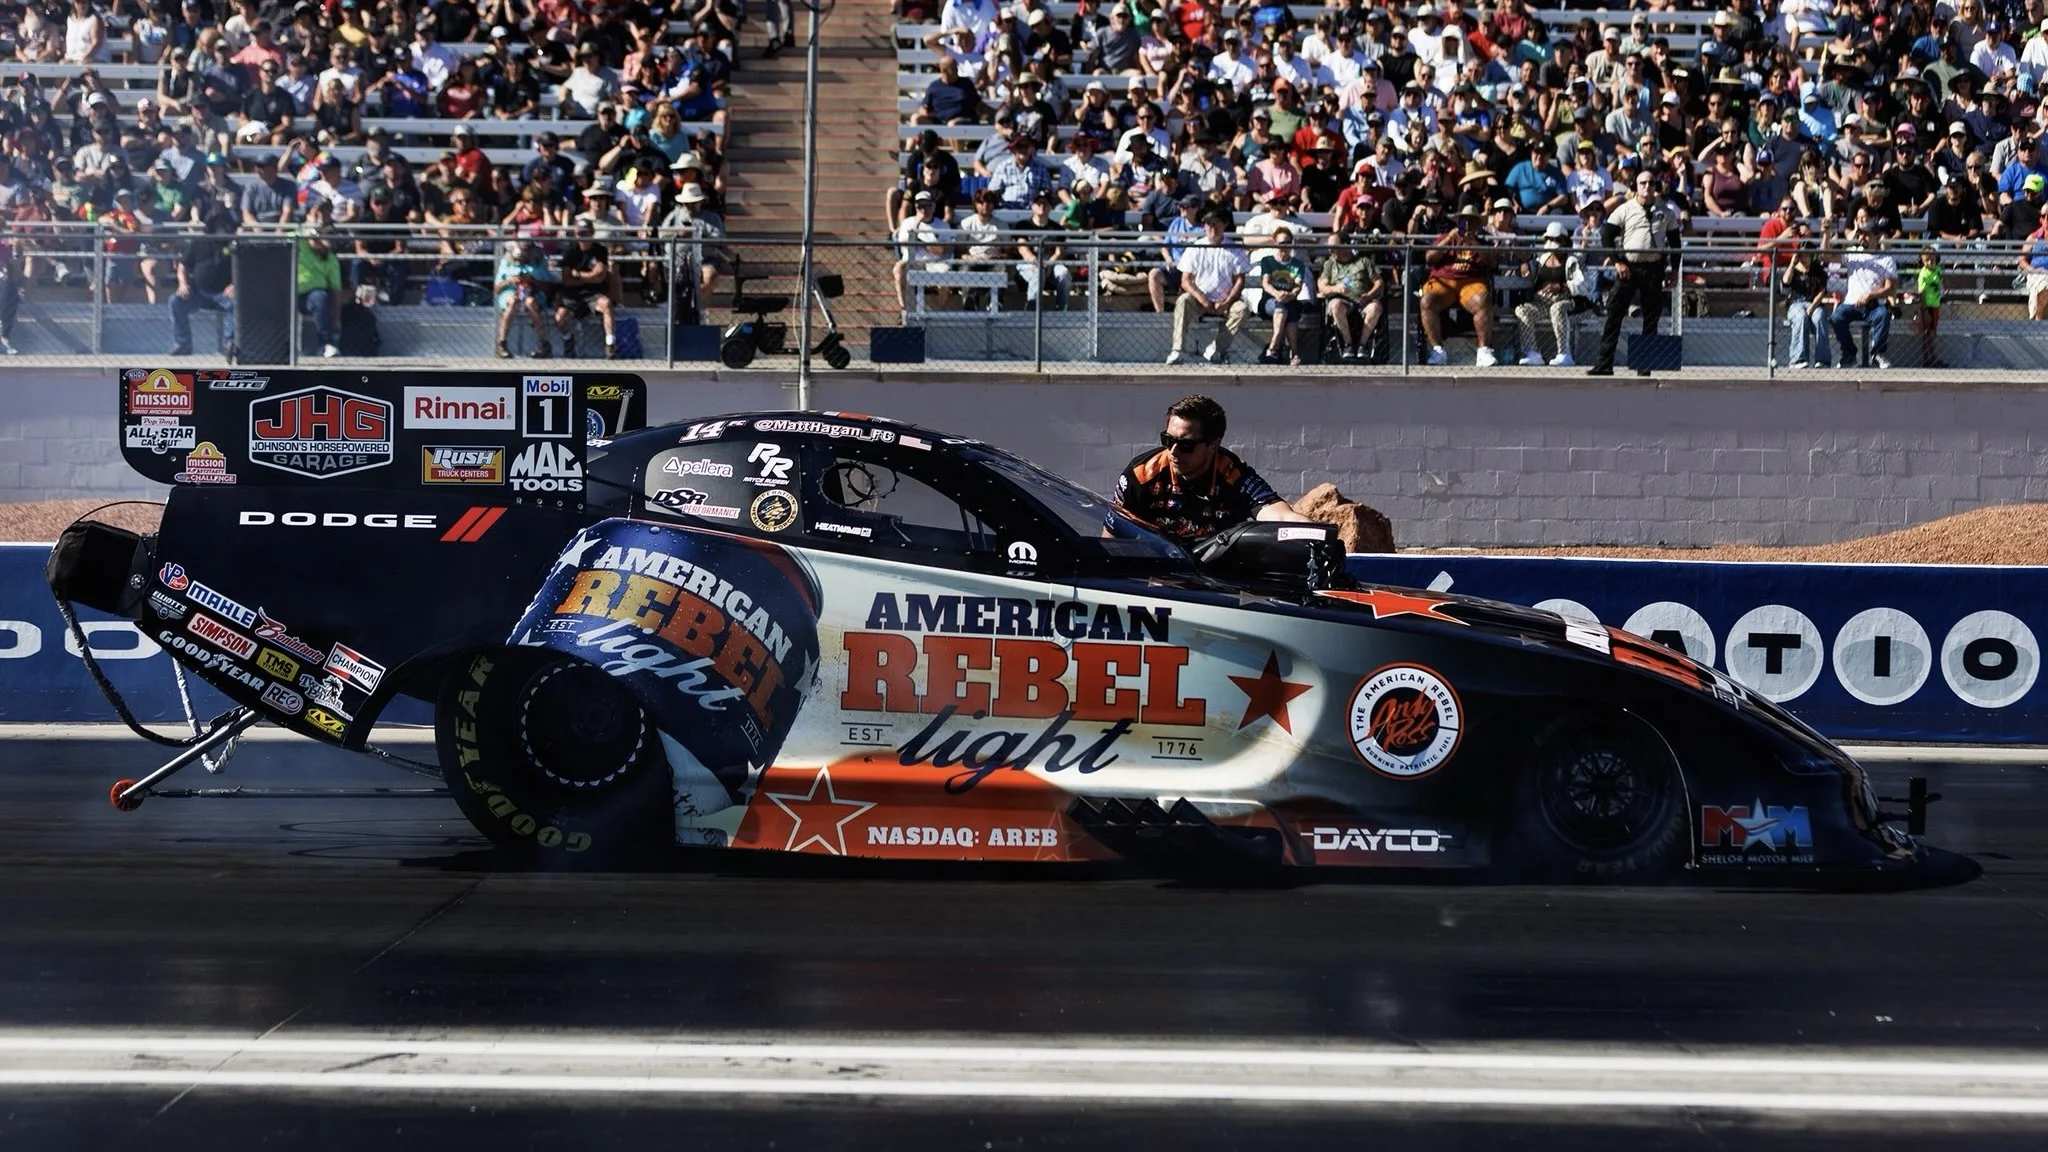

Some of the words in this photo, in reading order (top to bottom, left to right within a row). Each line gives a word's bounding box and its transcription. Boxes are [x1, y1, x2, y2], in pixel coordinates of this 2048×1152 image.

[526, 380, 569, 394] Mobil
[135, 394, 188, 406] MISSION
[415, 396, 506, 420] Rinnai
[255, 394, 386, 440] JHG
[539, 398, 553, 432] 1
[679, 420, 727, 443] 14
[754, 420, 896, 442] @MattHagan_FC
[252, 441, 308, 452] JOHNSON'S
[309, 441, 390, 453] HORSEPOWERED
[188, 459, 224, 467] MISSION
[273, 454, 368, 471] GARAGE
[509, 442, 583, 477] MAC
[437, 469, 460, 478] TRUCK
[460, 469, 489, 478] CENTERS
[509, 478, 583, 492] TOOLS
[651, 489, 707, 507] DSR
[756, 490, 797, 505] OPERATION
[239, 510, 437, 529] DODGE
[682, 504, 739, 518] PERFORMANCE
[752, 506, 772, 531] HEALING
[773, 510, 797, 531] FORCES
[163, 562, 185, 584] VP
[188, 583, 254, 627] MAHLE
[593, 545, 793, 665] AMERICAN
[549, 621, 574, 631] EST
[865, 592, 1172, 643] AMERICAN
[191, 616, 253, 656] SIMPSON
[554, 567, 786, 732] REBEL
[158, 630, 265, 692] GOODYEAR
[262, 661, 290, 678] TITANIUM
[265, 652, 293, 673] TMS
[331, 653, 378, 685] CHAMPION
[577, 617, 745, 712] light
[840, 631, 1206, 726] REBEL
[1356, 707, 1366, 731] THE
[1364, 673, 1425, 700] AMERICAN
[1431, 685, 1454, 721] REBEL
[848, 727, 884, 742] EST
[896, 704, 1134, 794] light
[1157, 741, 1197, 755] 1776
[1365, 746, 1395, 768] BURNING
[1399, 754, 1438, 771] PATRIOTIC
[1439, 735, 1451, 753] FUEL
[867, 826, 980, 847] NASDAQ:
[987, 827, 1058, 847] AREB
[1312, 828, 1440, 853] DAYCO
[1700, 854, 1744, 865] SHELOR
[1748, 854, 1788, 865] MOTOR
